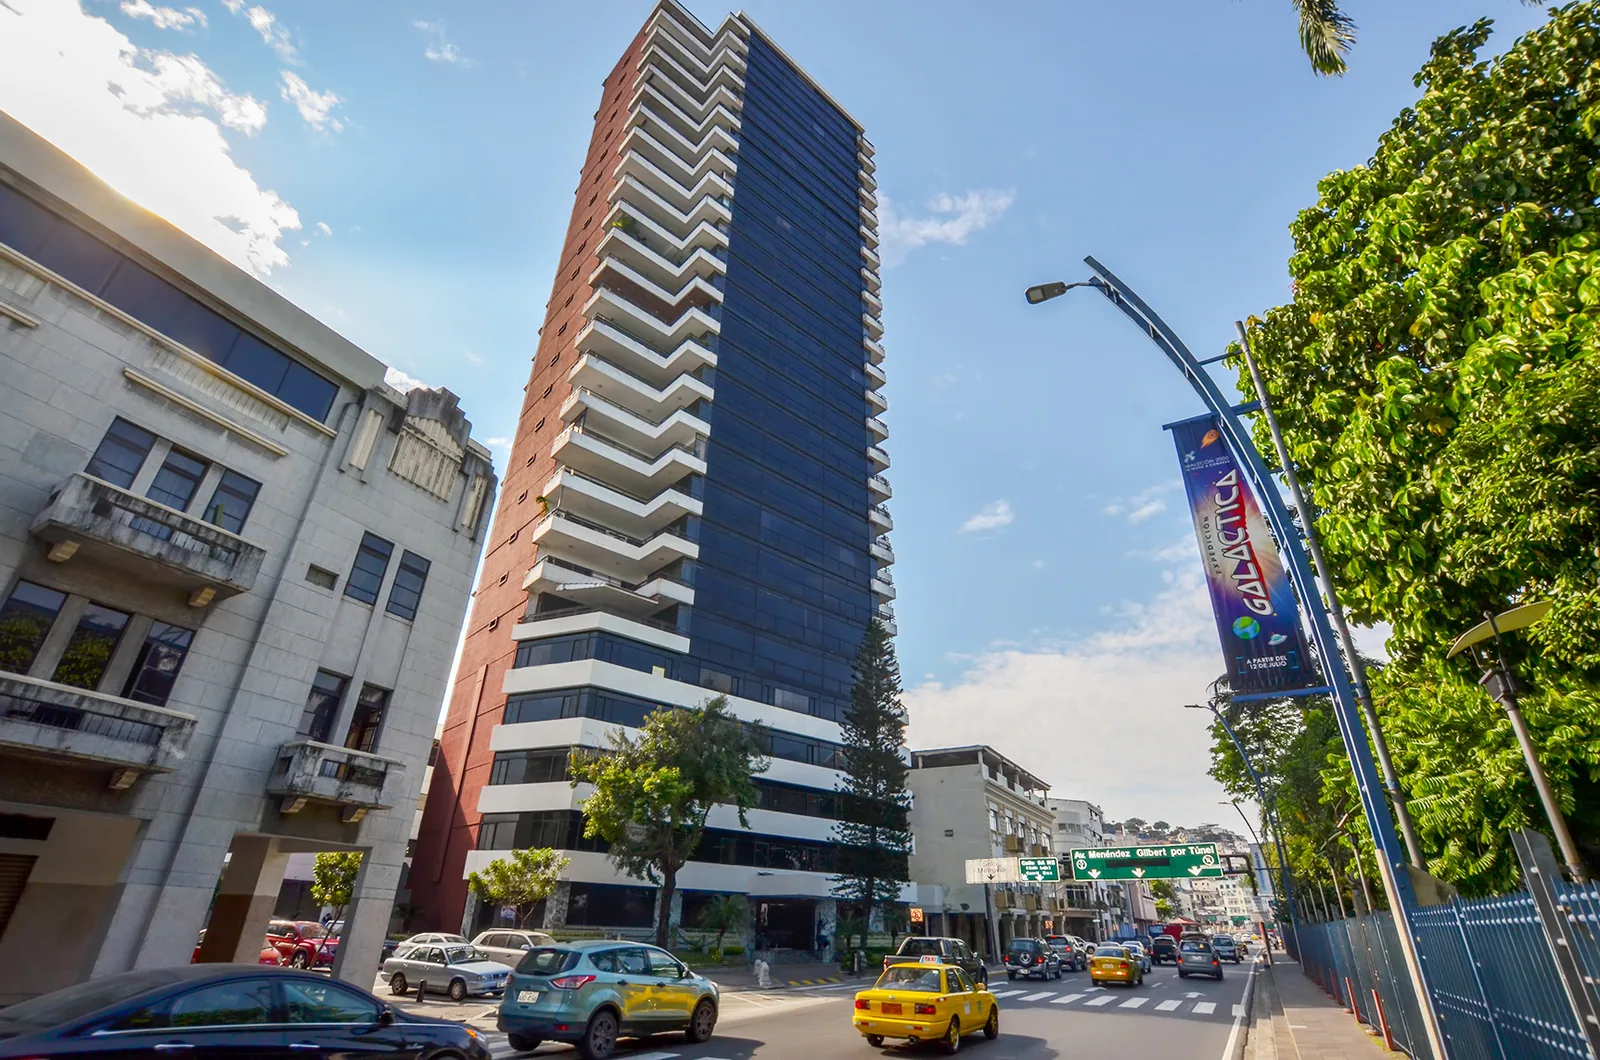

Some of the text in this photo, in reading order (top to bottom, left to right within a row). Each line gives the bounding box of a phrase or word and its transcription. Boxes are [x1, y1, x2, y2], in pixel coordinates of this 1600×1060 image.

[1184, 458, 1214, 469] MALECÓN
[1203, 516, 1222, 574] EXPEDICIÓN
[1268, 660, 1287, 668] JULIO
[1074, 845, 1215, 859] Av. Menéndez Gilbert por Túnel
